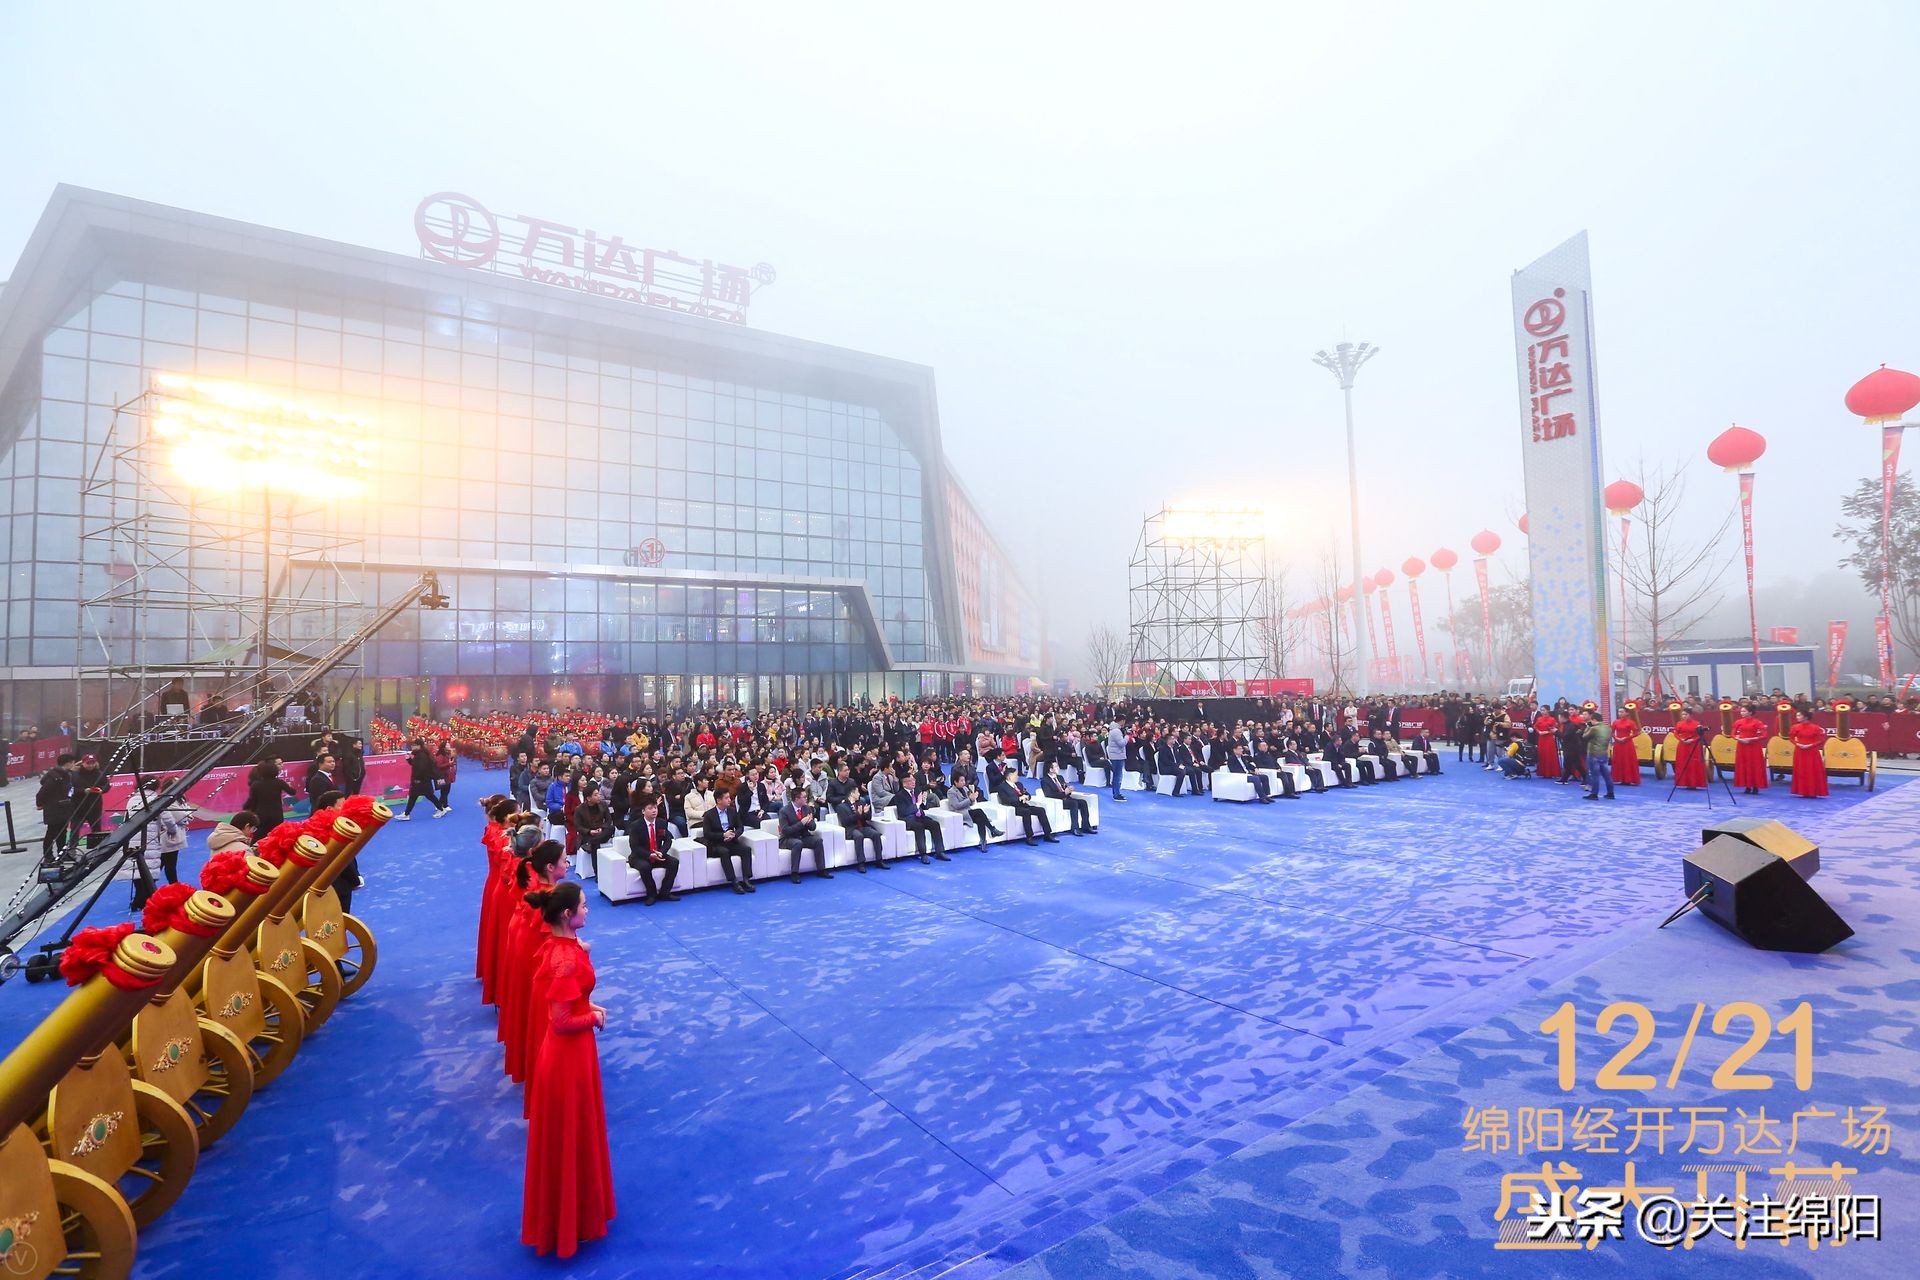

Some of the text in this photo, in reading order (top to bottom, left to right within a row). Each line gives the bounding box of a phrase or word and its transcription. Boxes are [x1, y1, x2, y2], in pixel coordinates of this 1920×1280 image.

[516, 214, 751, 307] 万达广场
[519, 263, 746, 322] WANDA PLAZA
[1536, 334, 1576, 441] 万达广场
